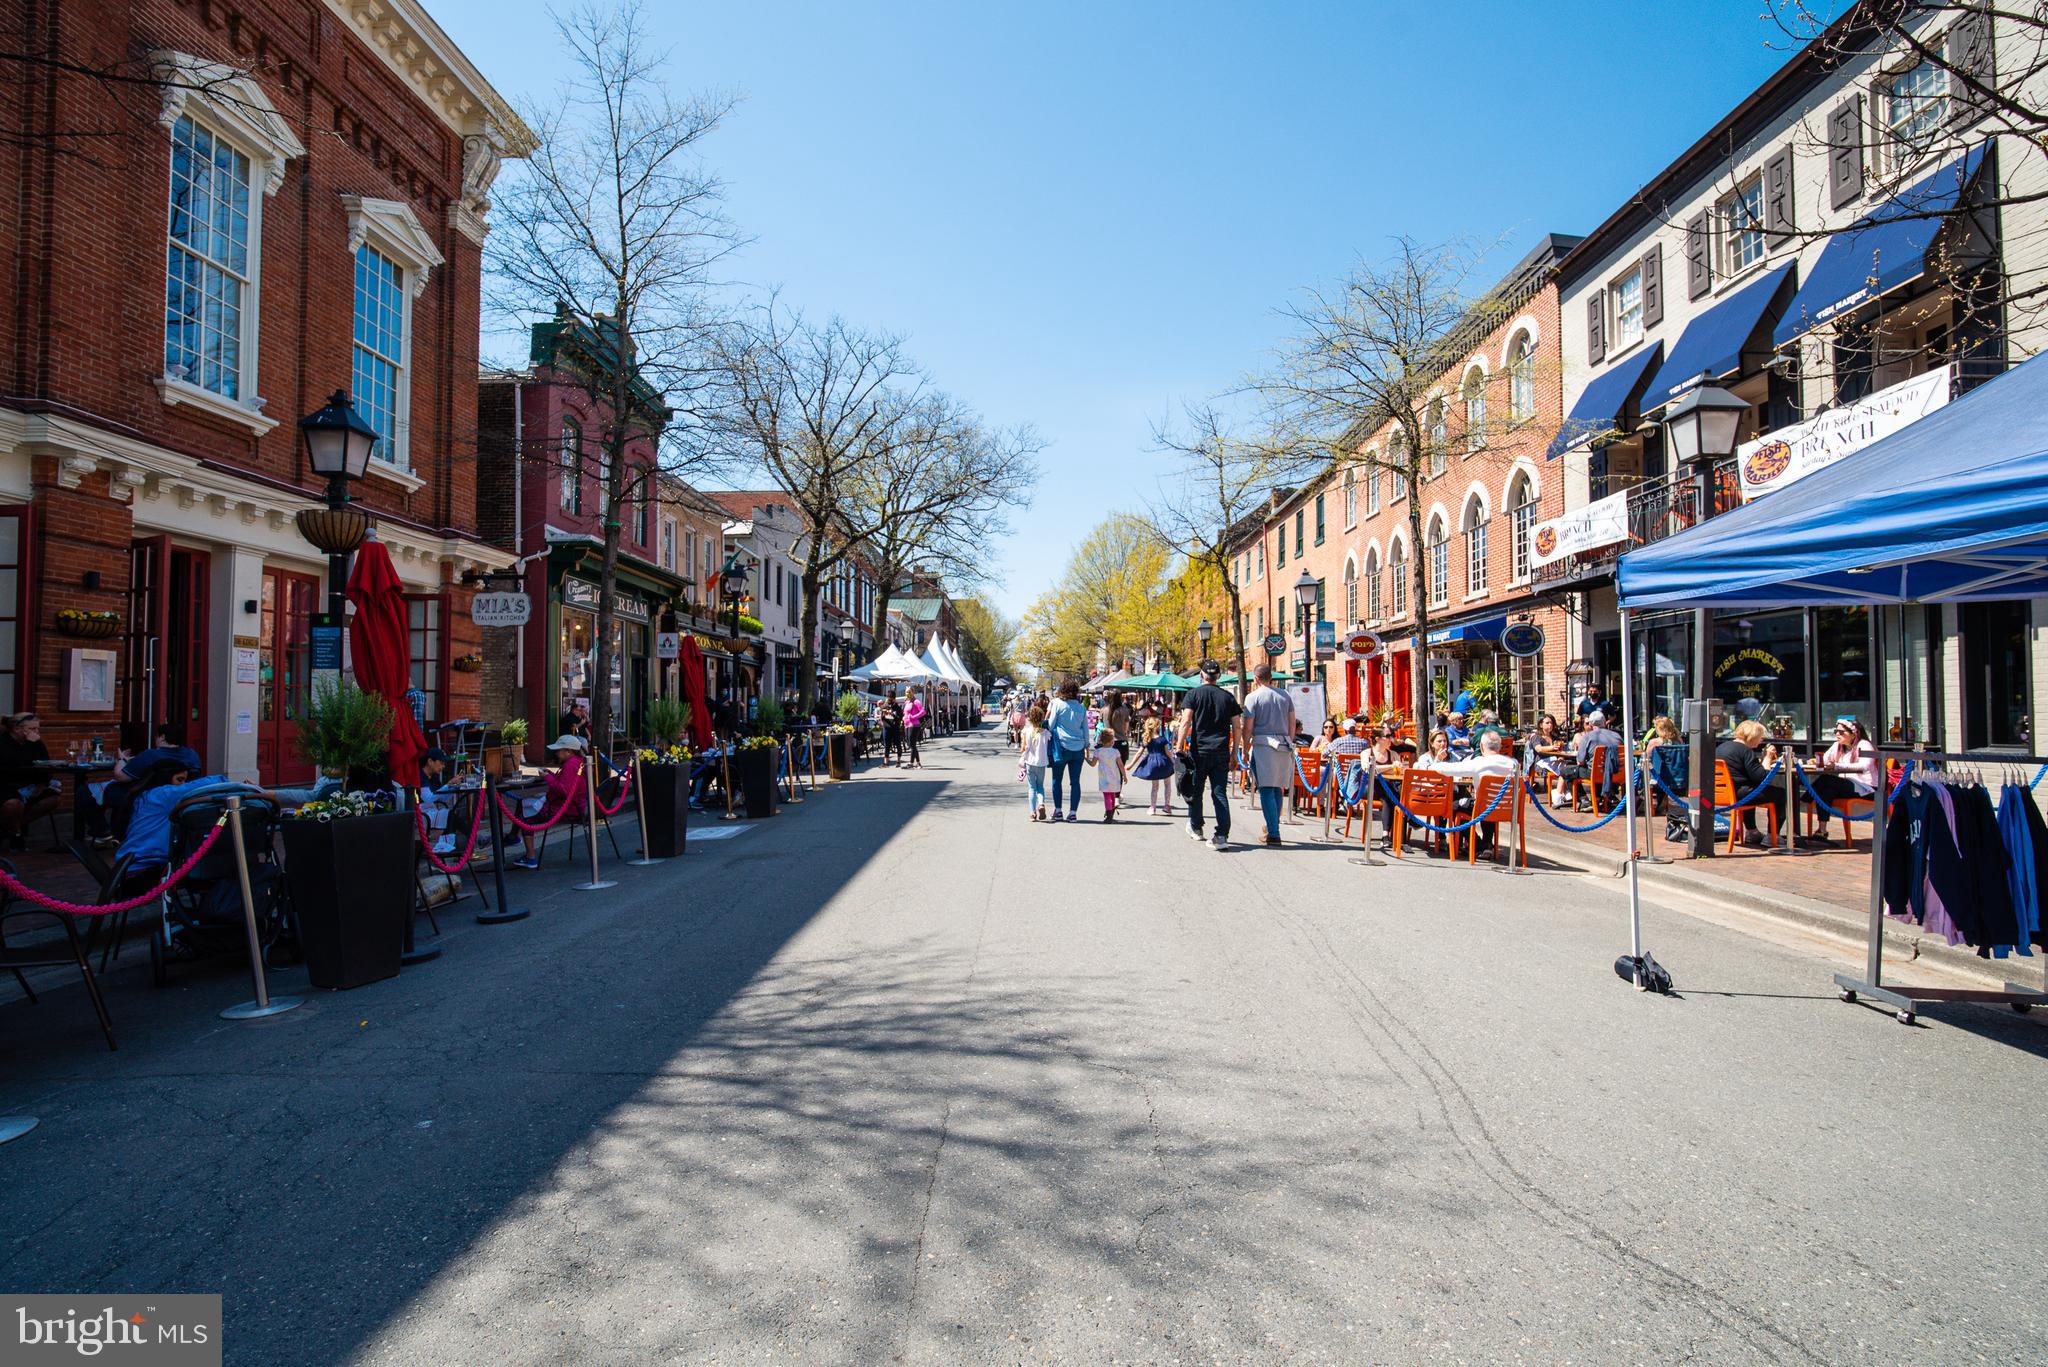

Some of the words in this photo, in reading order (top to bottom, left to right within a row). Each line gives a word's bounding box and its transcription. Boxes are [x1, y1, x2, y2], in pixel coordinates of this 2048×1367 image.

[1754, 441, 1781, 460] FISH
[1801, 421, 1874, 458] BRUNCH
[475, 597, 526, 614] MIA'S
[613, 594, 647, 617] CREAM
[1715, 654, 1736, 678] FISH
[1738, 648, 1786, 675] MARKET
